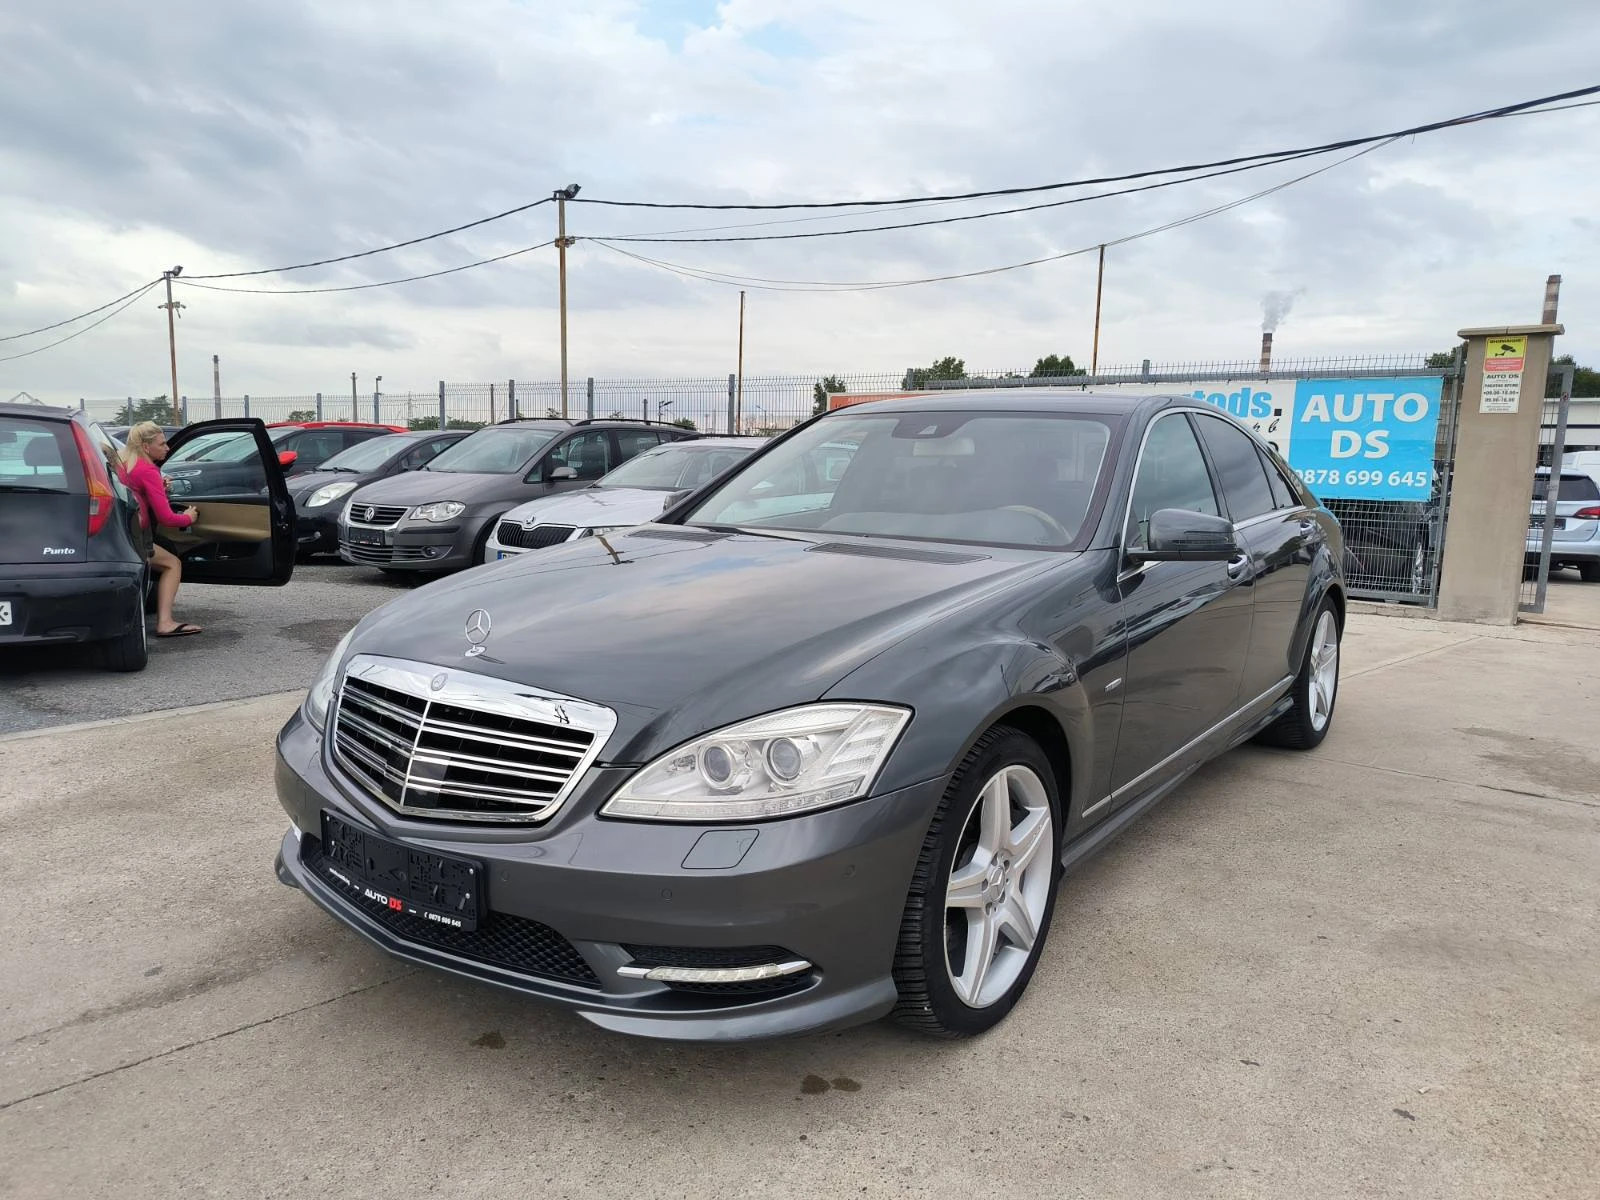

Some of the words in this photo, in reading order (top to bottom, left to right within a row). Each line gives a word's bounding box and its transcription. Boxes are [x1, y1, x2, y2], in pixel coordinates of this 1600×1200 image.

[1301, 393, 1429, 423] AUTO
[1330, 430, 1390, 459] DS
[1345, 470, 1383, 486] 699
[1388, 471, 1427, 487] 645
[43, 547, 75, 555] Punto
[364, 888, 388, 905] AUTO
[389, 897, 402, 911] DS
